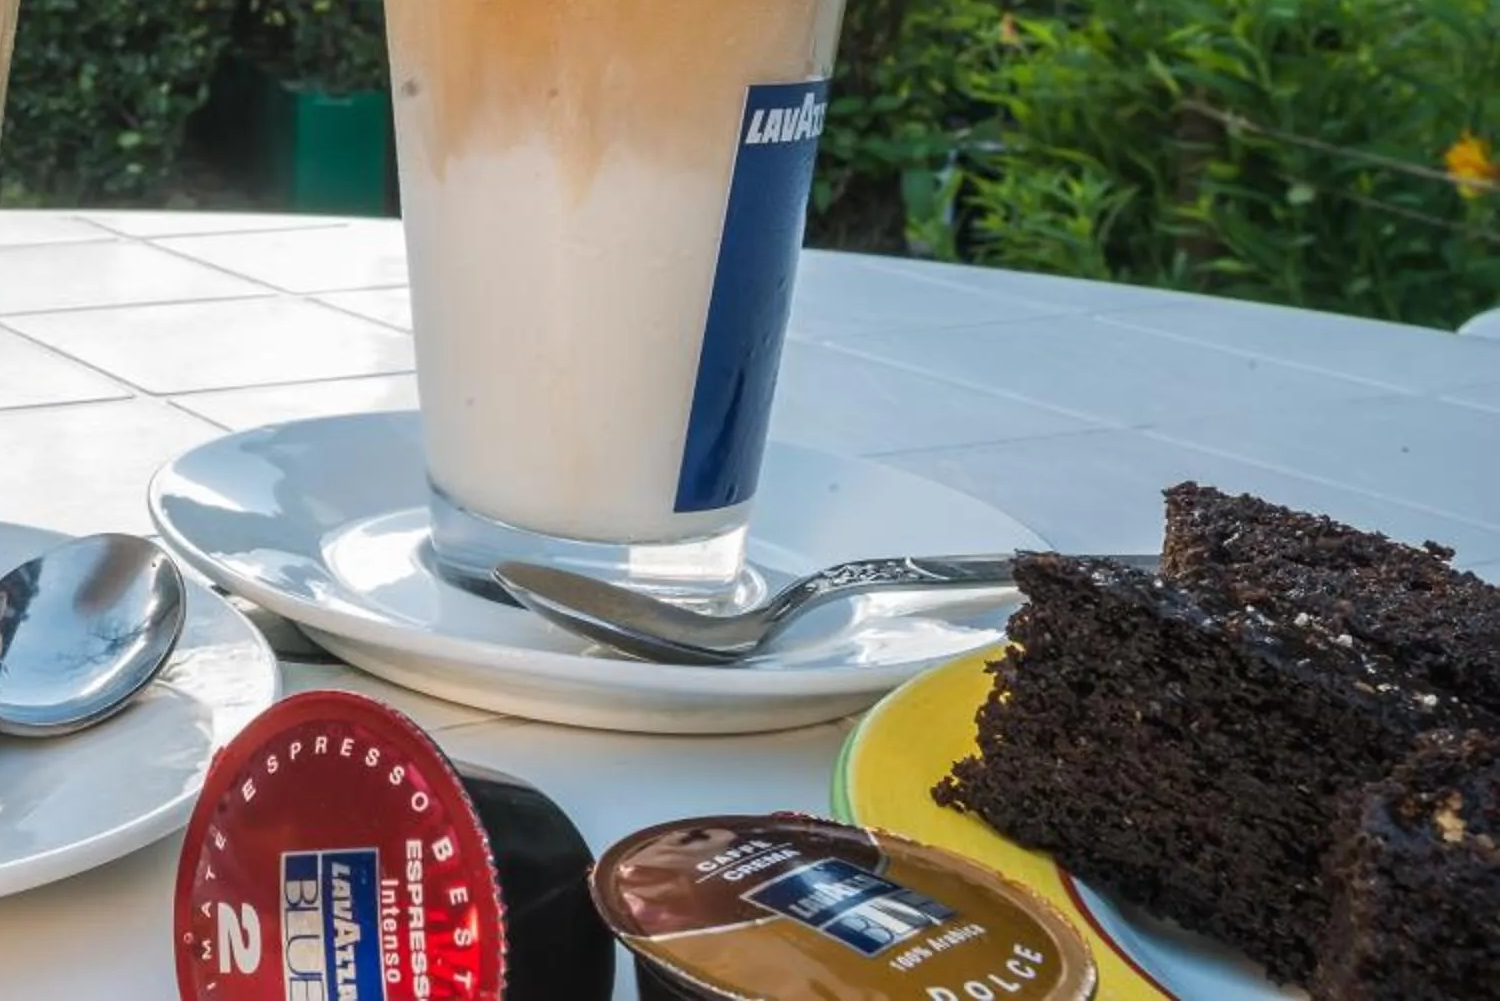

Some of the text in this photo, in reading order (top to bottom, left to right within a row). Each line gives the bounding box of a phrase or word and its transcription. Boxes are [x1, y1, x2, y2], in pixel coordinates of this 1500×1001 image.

[241, 736, 428, 811] ESPRESSO
[722, 849, 801, 881] CREMA
[217, 902, 262, 974] 2
[381, 879, 401, 983] Intenso
[406, 840, 431, 1001] ESPRESS
[888, 923, 987, 972] 100% Arabica
